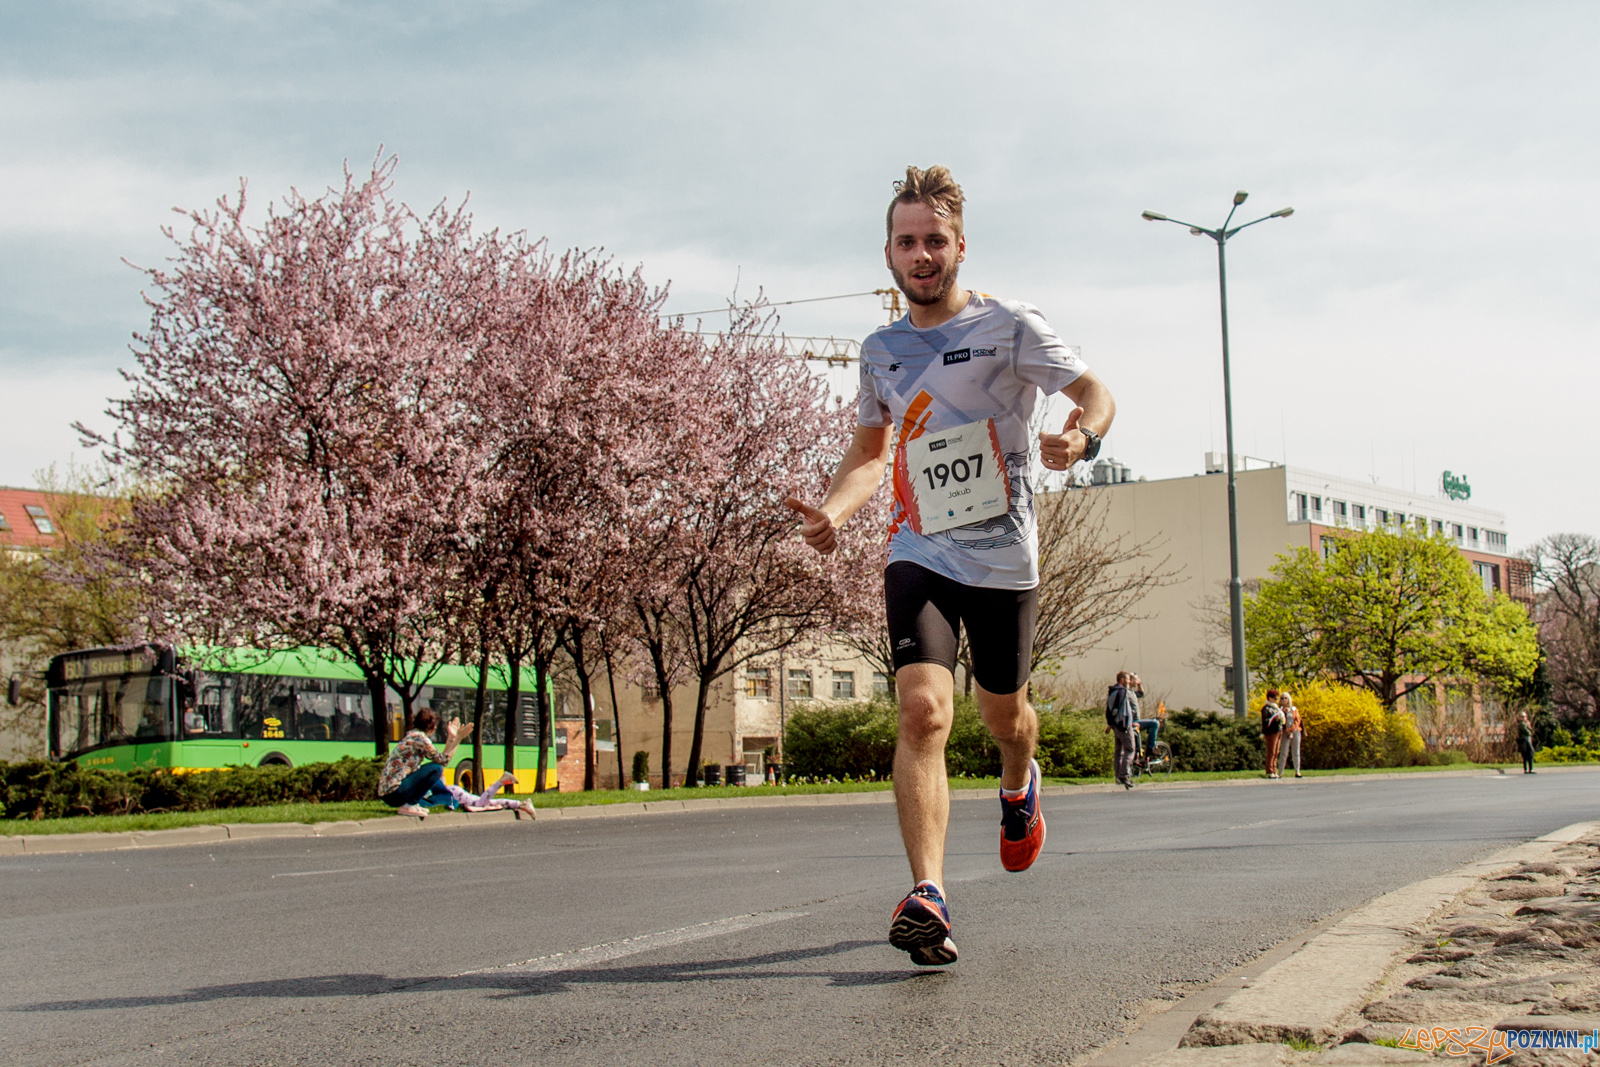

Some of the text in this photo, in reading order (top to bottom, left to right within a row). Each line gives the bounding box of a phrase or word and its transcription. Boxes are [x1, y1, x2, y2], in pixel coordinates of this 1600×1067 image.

[888, 361, 903, 372] 4F
[922, 453, 983, 490] 1907
[947, 487, 971, 499] Jakub
[262, 730, 285, 739] 1648
